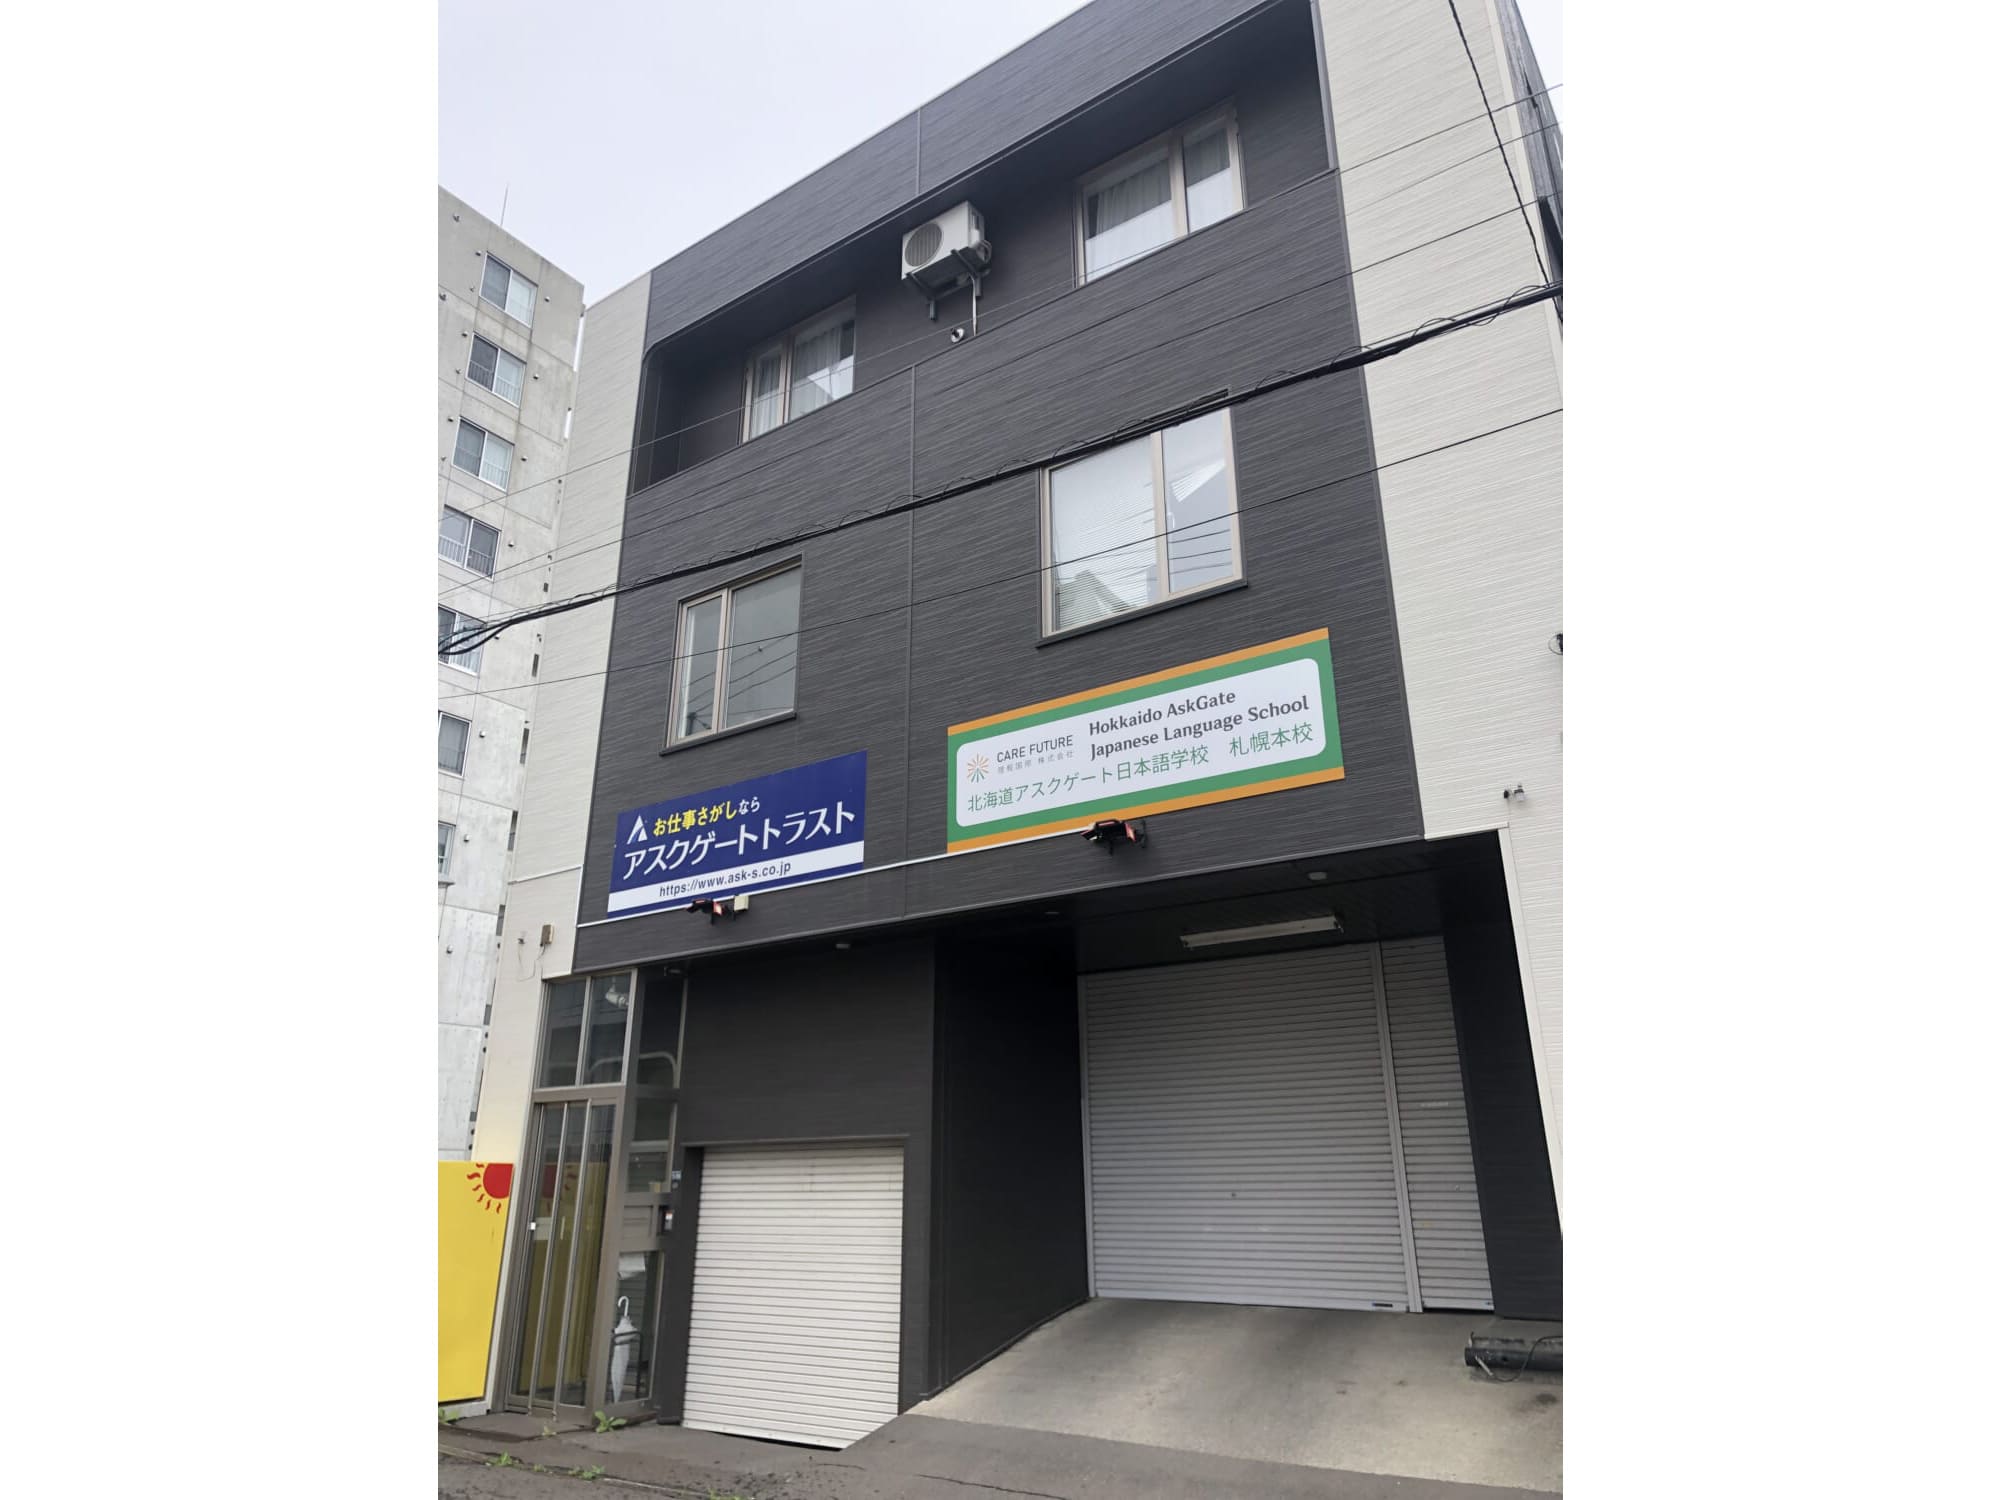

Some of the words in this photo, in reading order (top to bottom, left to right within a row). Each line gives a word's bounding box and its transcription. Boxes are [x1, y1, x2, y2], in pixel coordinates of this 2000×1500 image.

[1089, 708, 1162, 736] Hokkaido
[1166, 691, 1236, 718] AskGate
[1091, 735, 1159, 761] Japanese
[1163, 713, 1243, 741] Language
[1248, 695, 1309, 721] School
[967, 744, 1209, 812] 北海道アスクゲート日本語学校
[1229, 721, 1314, 757] 札幌本校
[997, 746, 1026, 763] CARE
[1029, 735, 1073, 755] FUTURE
[653, 796, 760, 837] お仕事さがしなら
[623, 801, 855, 880] アスクゲートトラスト
[659, 862, 791, 897] https://www.ask-s.co.jp
